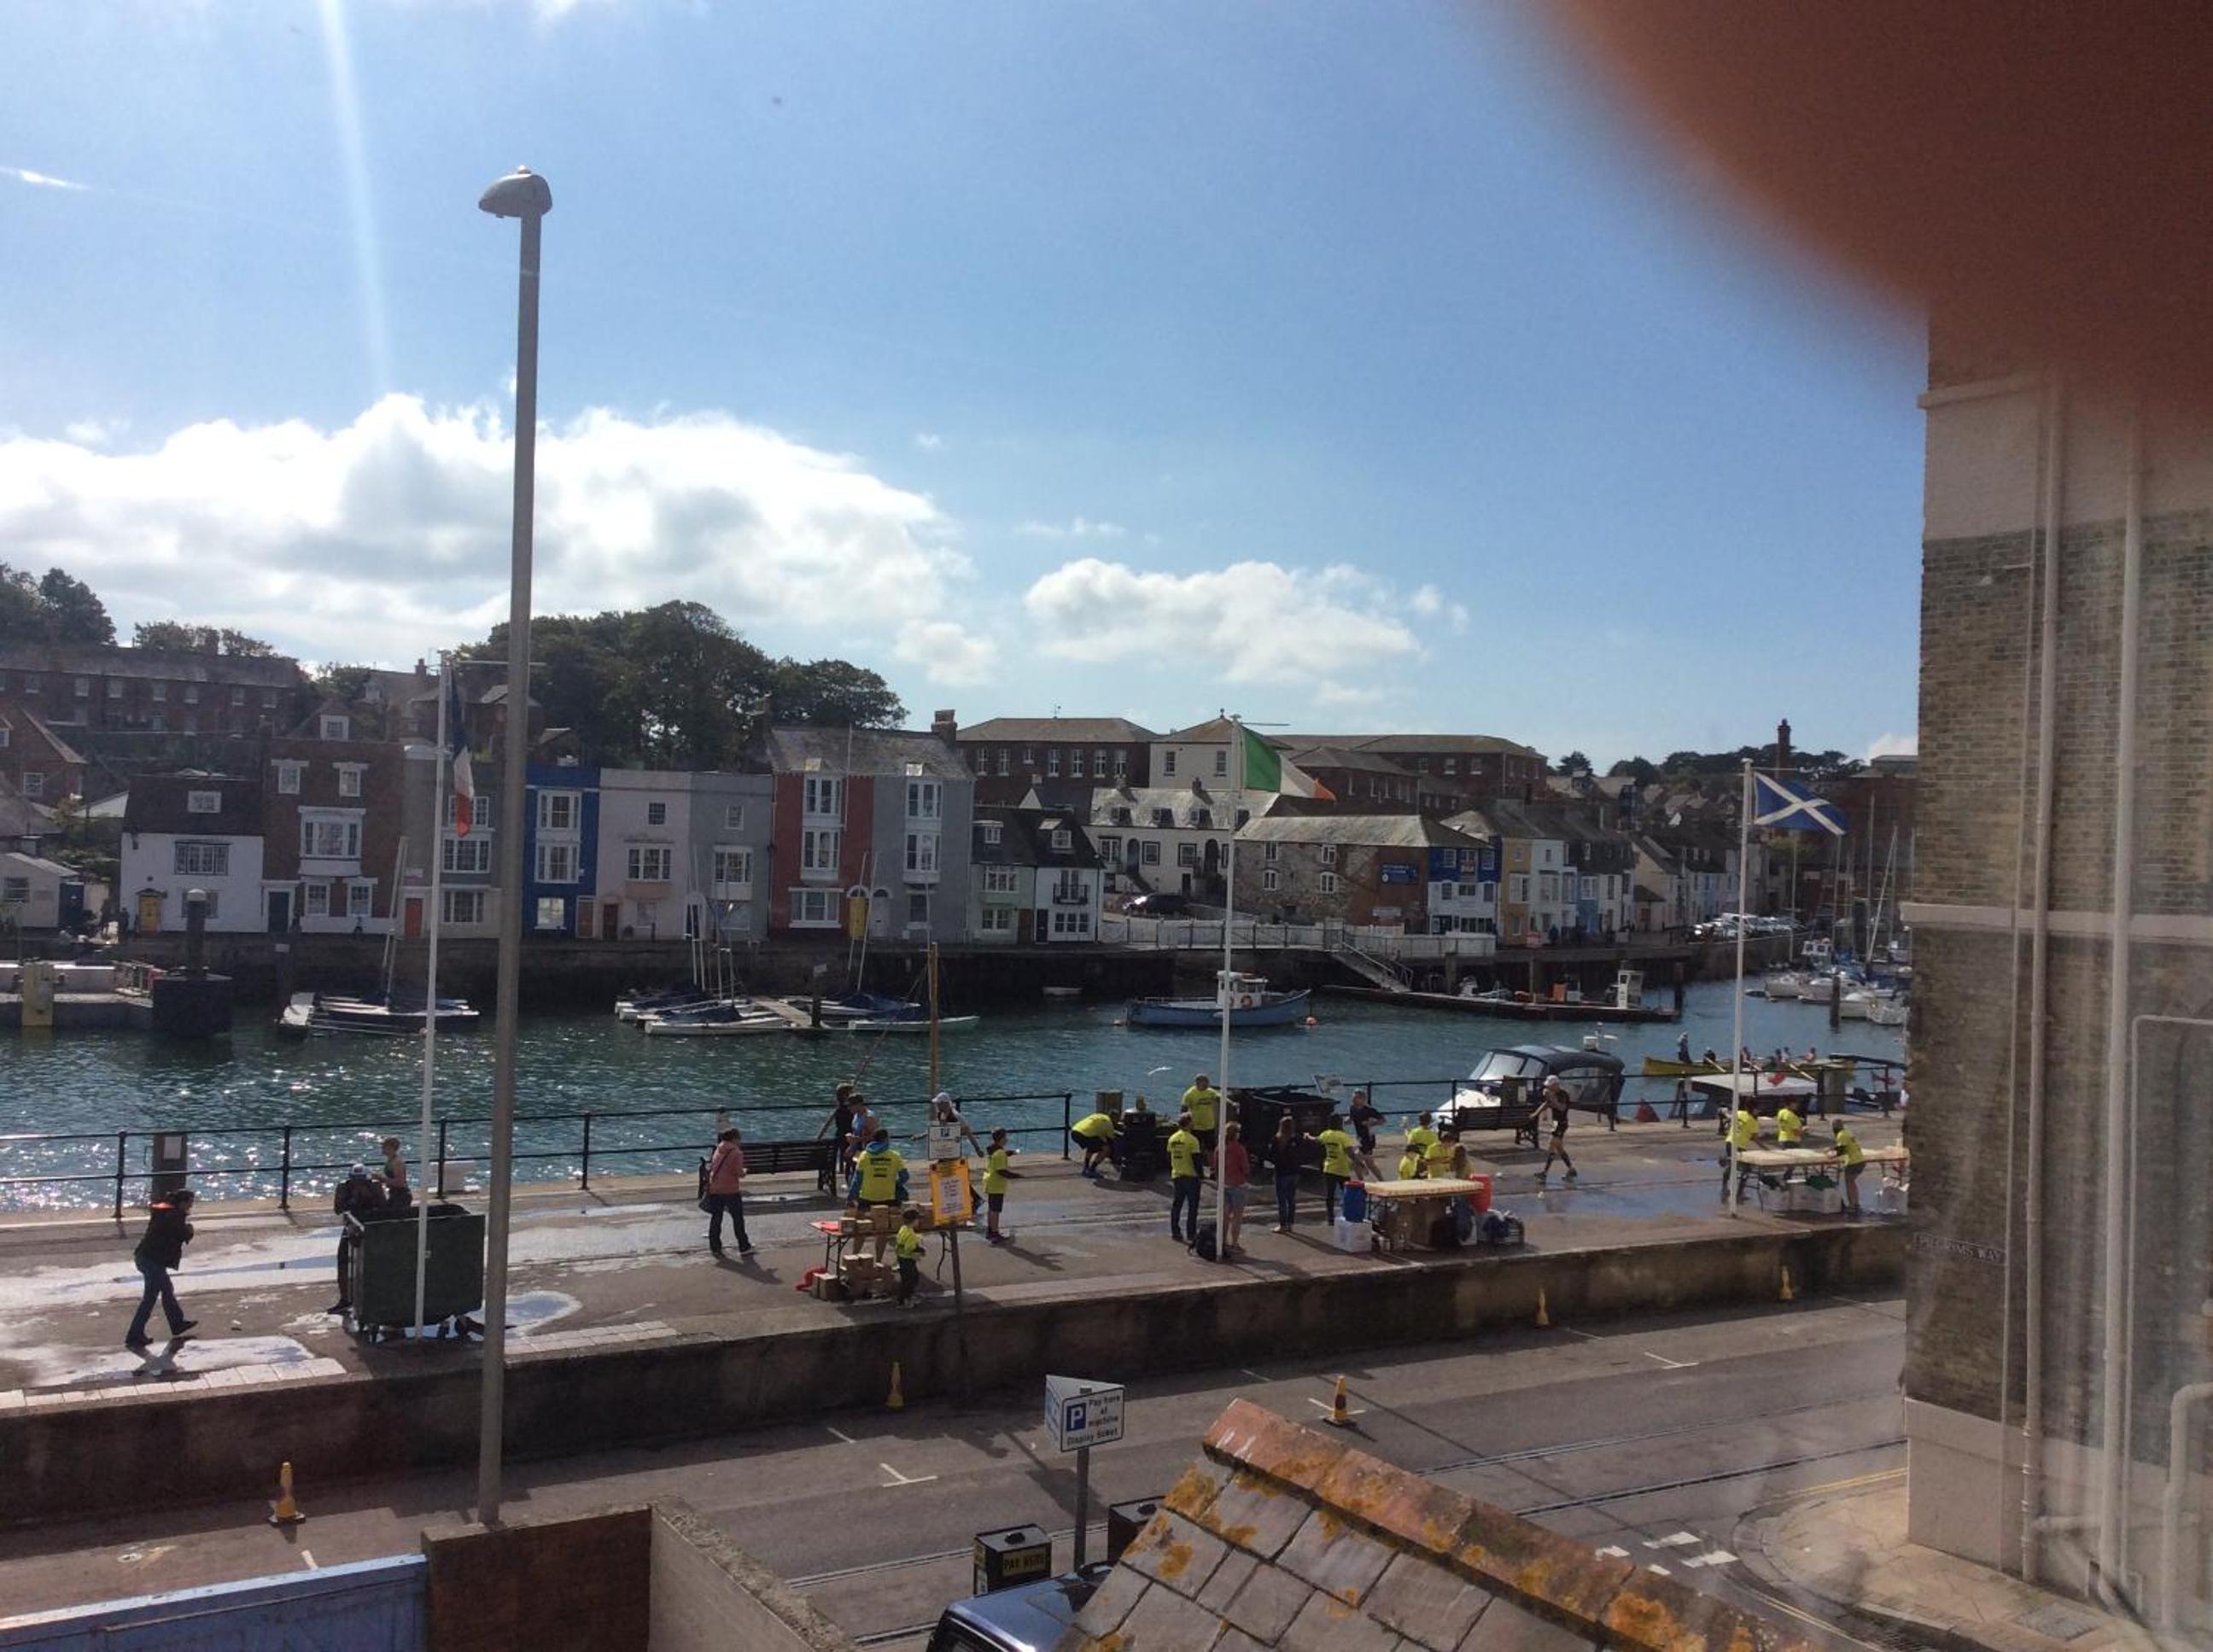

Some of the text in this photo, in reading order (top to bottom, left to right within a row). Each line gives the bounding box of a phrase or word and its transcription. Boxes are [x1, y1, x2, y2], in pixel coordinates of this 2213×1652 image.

[1977, 1246, 2001, 1262] WAY
[1071, 1406, 1083, 1429] P
[1066, 1433, 1094, 1447] Display
[1003, 1556, 1020, 1571] PAY
